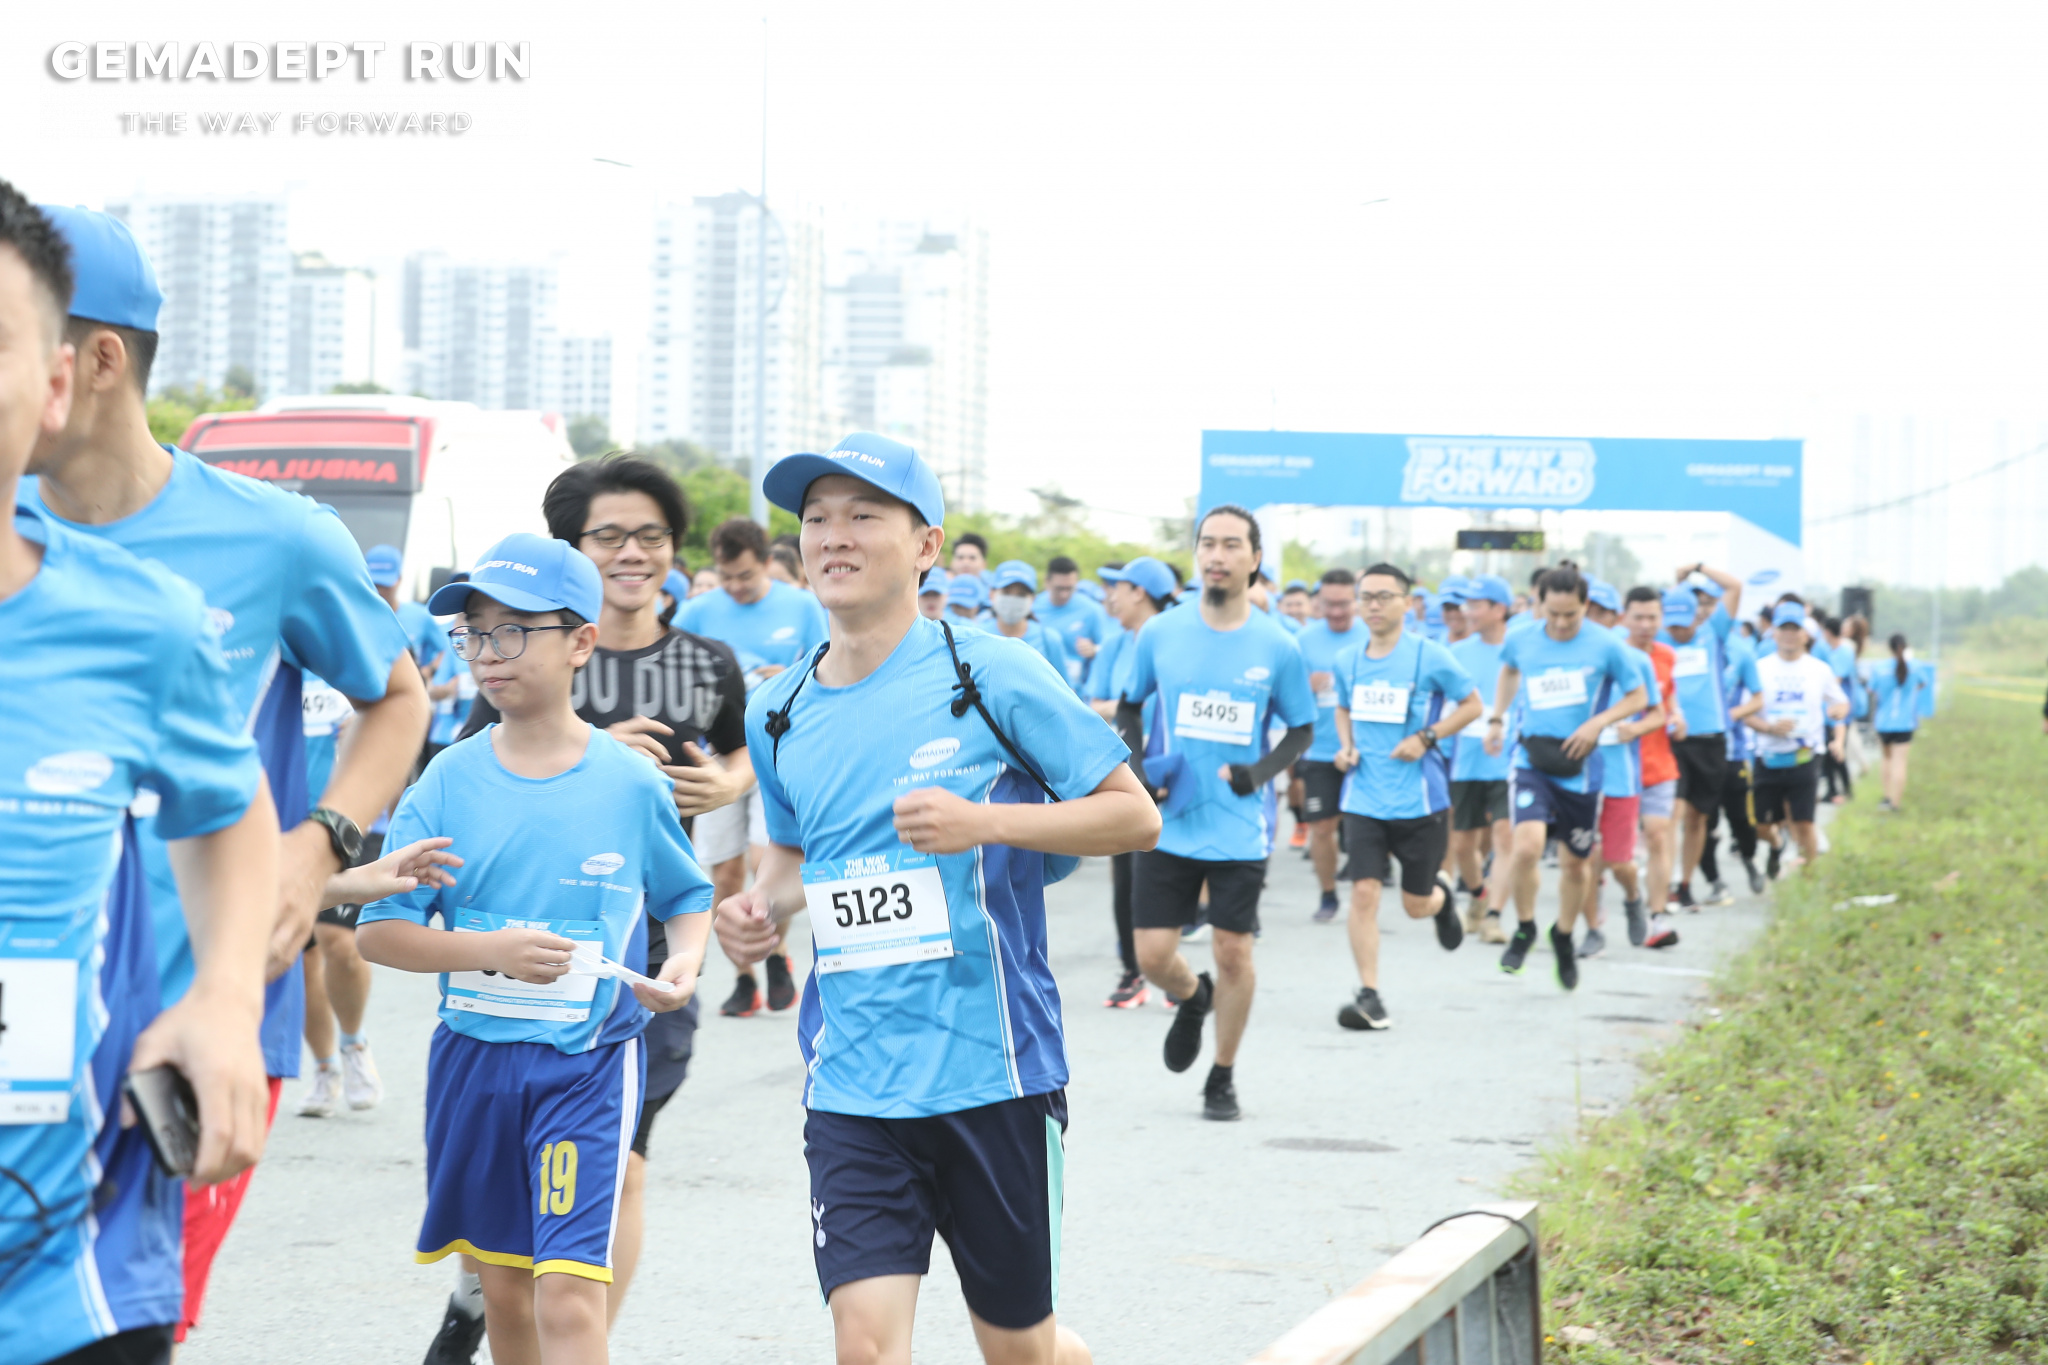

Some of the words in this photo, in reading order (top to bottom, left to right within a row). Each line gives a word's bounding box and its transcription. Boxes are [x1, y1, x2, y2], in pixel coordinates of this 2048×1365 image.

[859, 453, 886, 469] RUN
[1449, 446, 1496, 467] THE
[1500, 448, 1557, 468] WAY
[1411, 466, 1584, 495] FORWARD
[512, 563, 539, 577] RUN
[1191, 700, 1239, 723] 5495
[893, 775, 908, 787] THE
[911, 772, 931, 783] WAY
[934, 764, 980, 779] FORWARD
[844, 863, 890, 879] FORWARD
[846, 857, 864, 871] THE
[864, 854, 887, 868] WAY
[832, 883, 913, 927] 5123
[505, 919, 527, 929] THE
[539, 1140, 578, 1216] 19
